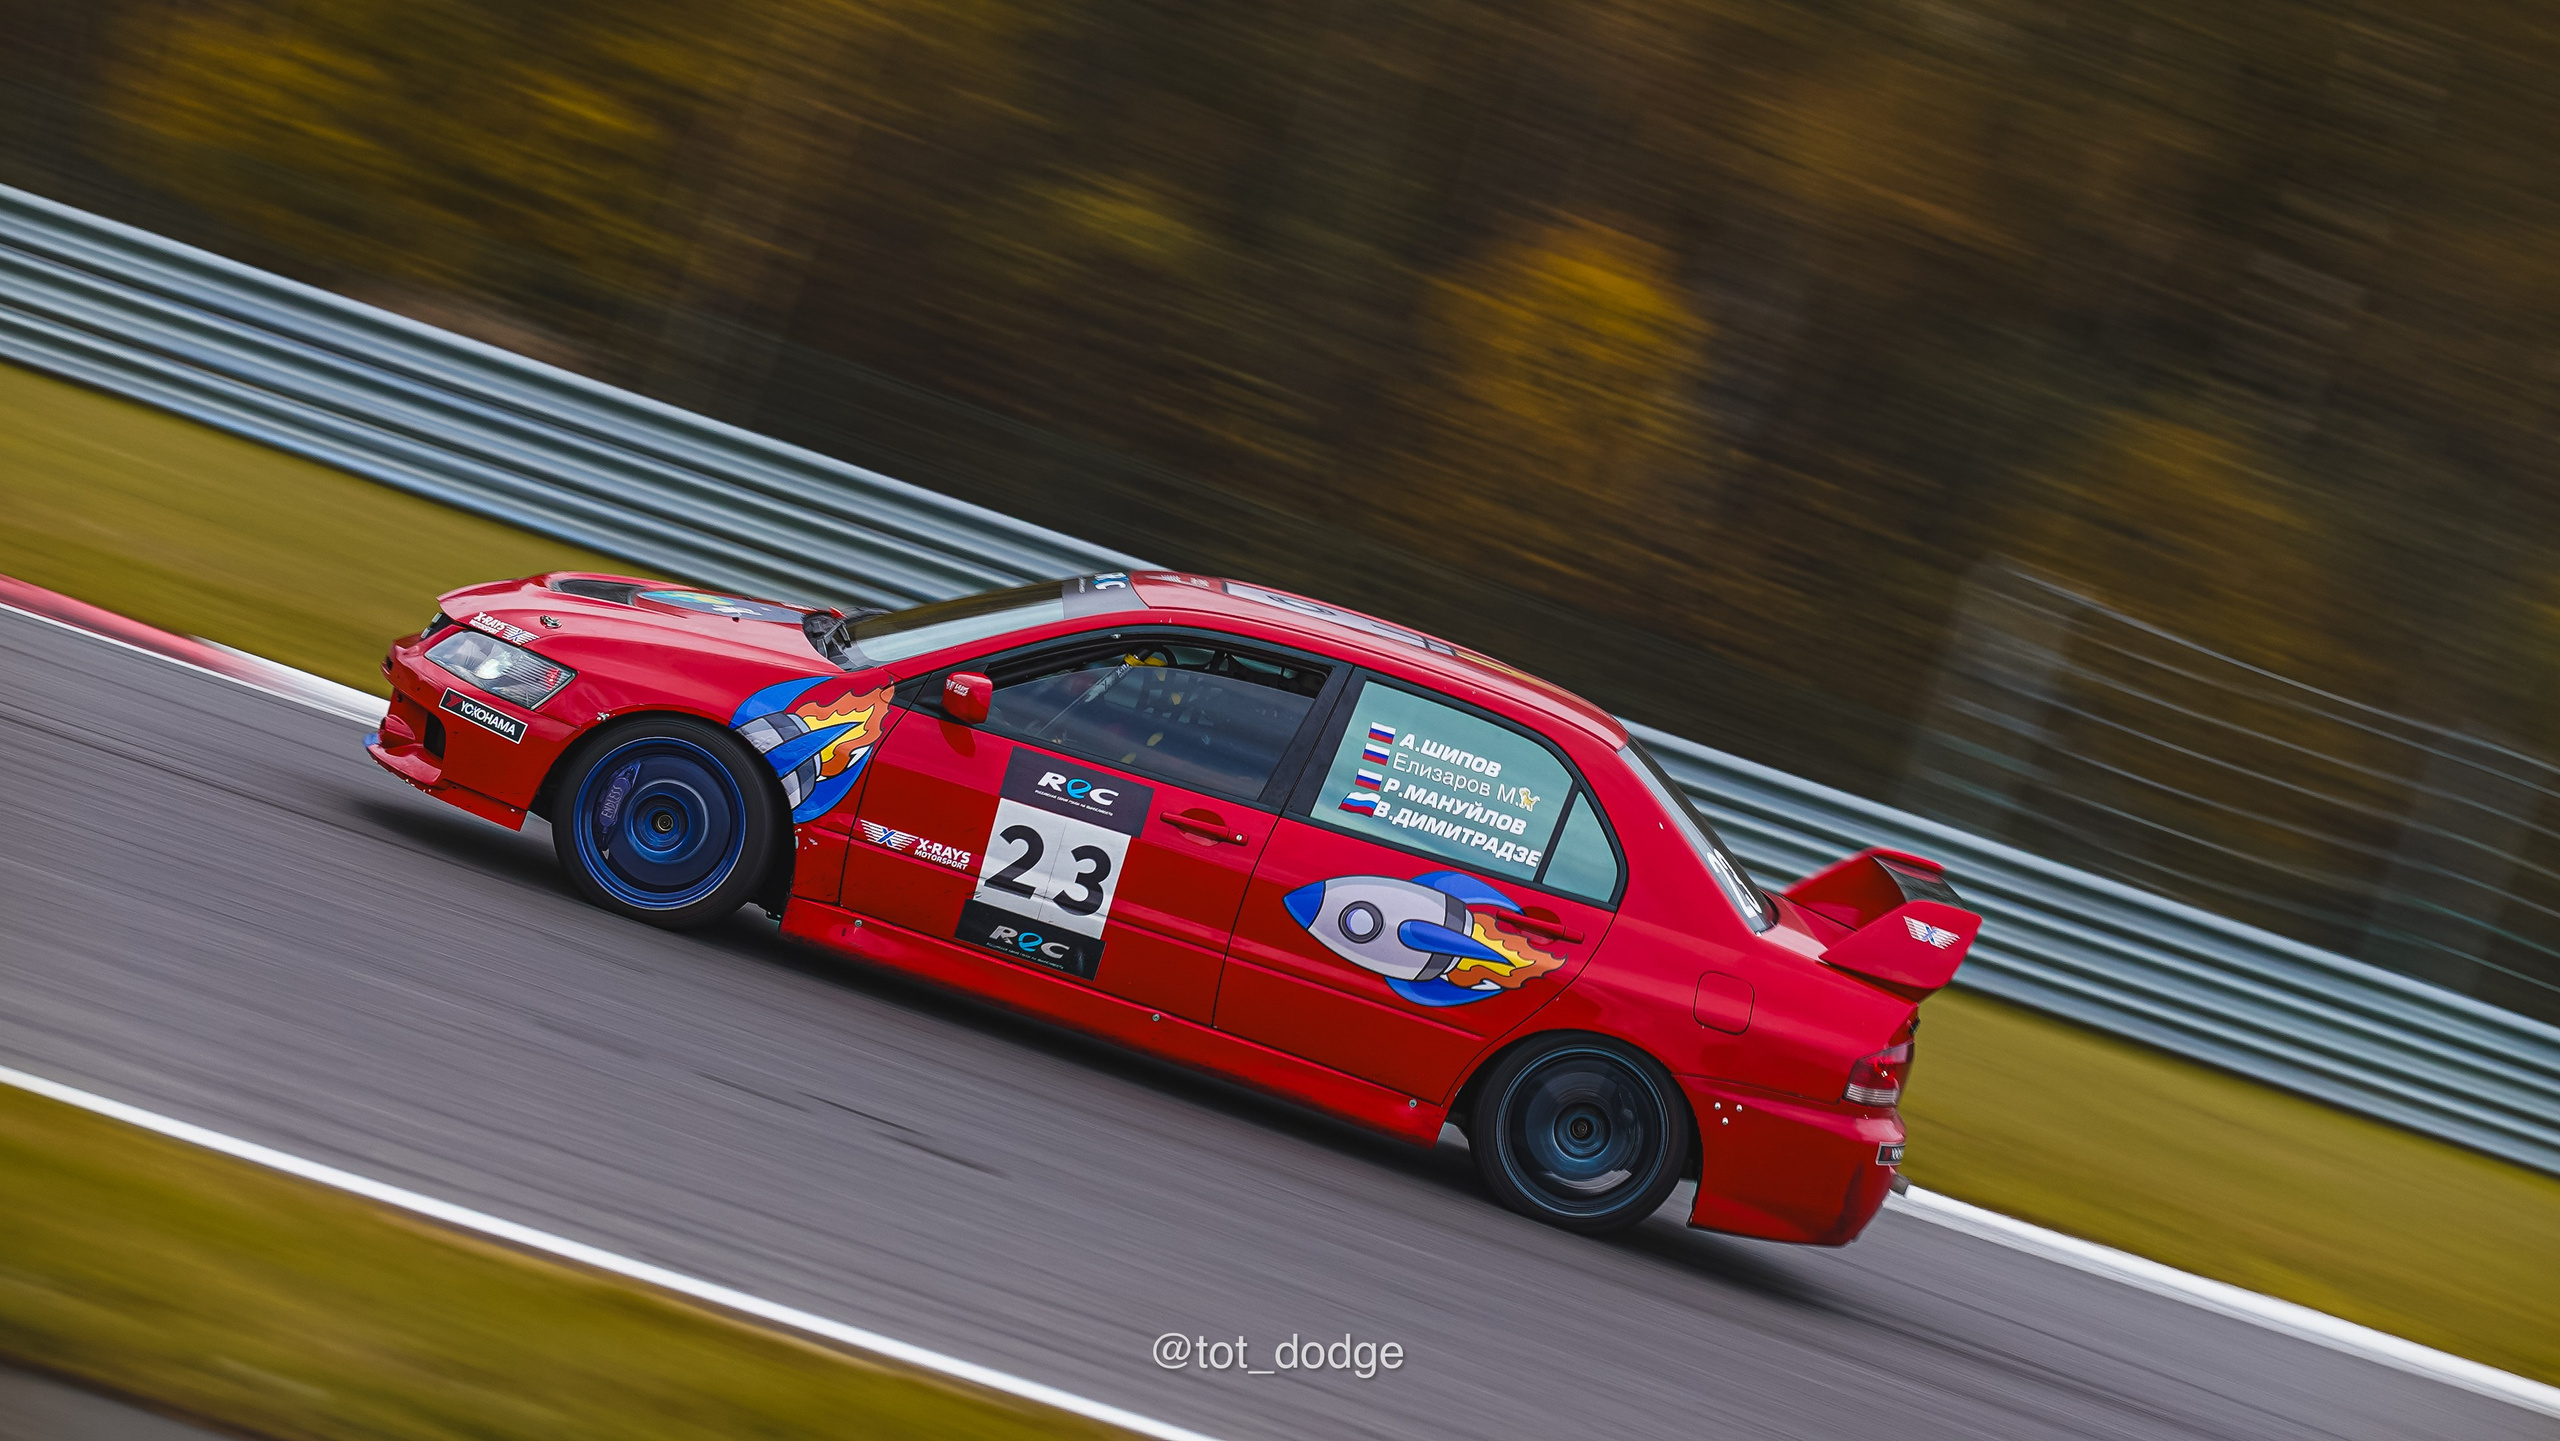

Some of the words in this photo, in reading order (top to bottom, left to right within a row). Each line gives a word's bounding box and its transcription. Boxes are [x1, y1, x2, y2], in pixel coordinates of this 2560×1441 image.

[473, 611, 507, 631] X-RAYS
[461, 701, 516, 736] YOKOHAMA
[1392, 752, 1491, 796] Елизаров
[1399, 733, 1502, 778] А.ШИПОВ
[601, 784, 623, 819] ENDLESS
[1383, 777, 1527, 836] Р.МАНУЙЛОВ
[916, 838, 972, 864] X-RAYS
[1374, 801, 1542, 868] В.ДИМИТРАДЗЕ
[914, 849, 968, 870] MOTORSPORT
[984, 824, 1112, 917] 23
